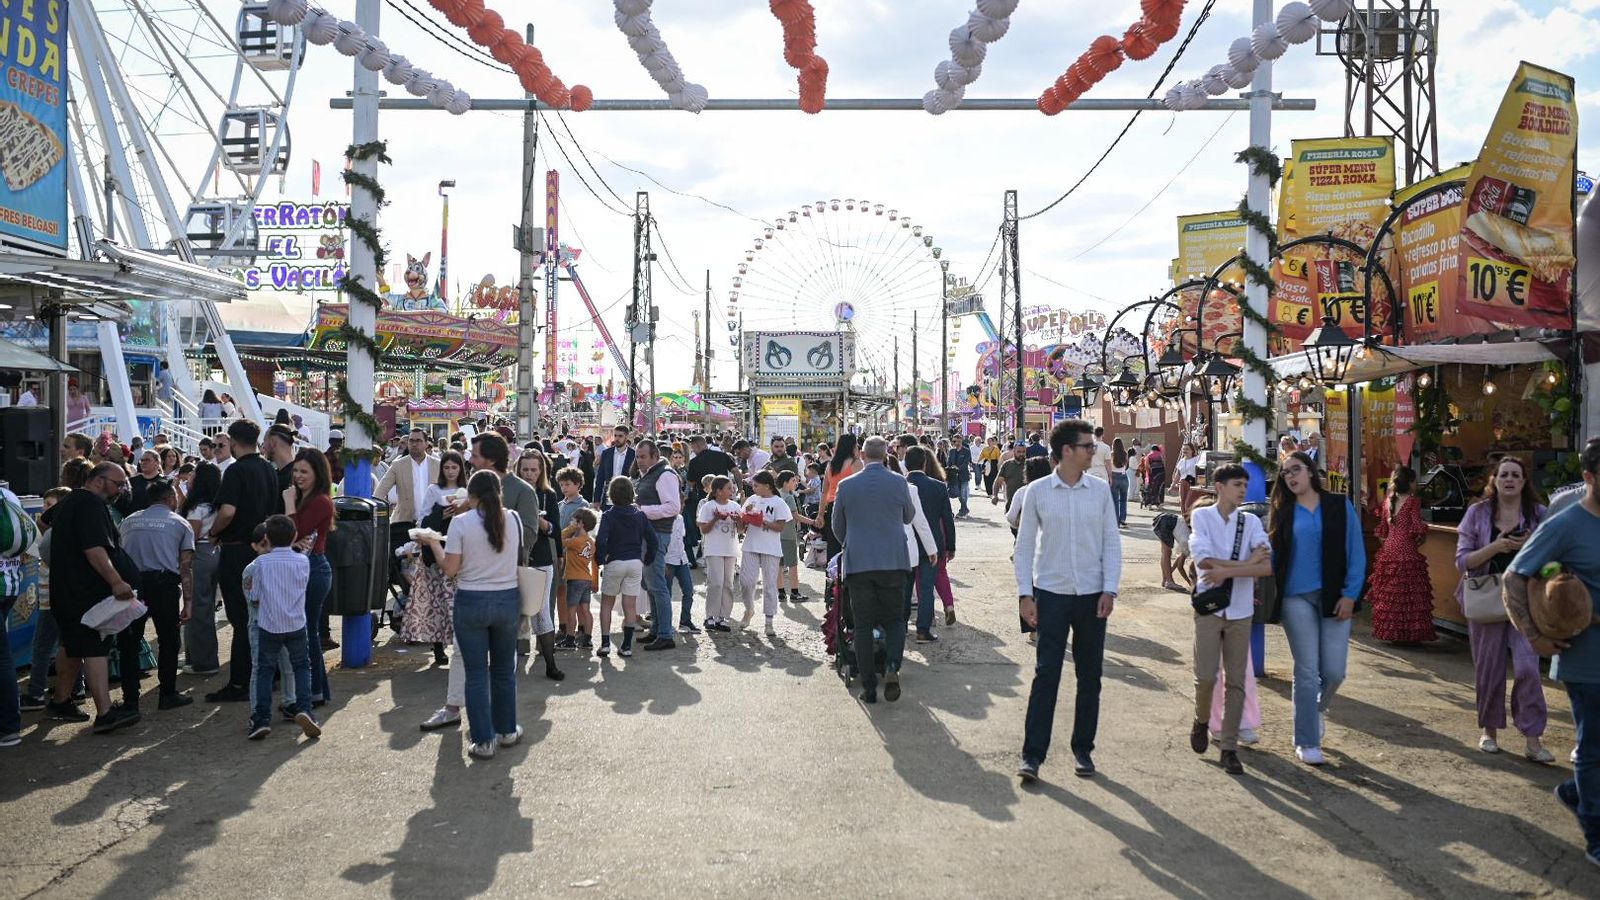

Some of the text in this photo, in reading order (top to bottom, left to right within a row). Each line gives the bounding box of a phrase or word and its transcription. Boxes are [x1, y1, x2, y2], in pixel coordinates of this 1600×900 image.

[1, 0, 59, 34] ES
[7, 67, 59, 107] CREPES
[1306, 149, 1379, 160] PIZZERÍA ROMA
[1309, 160, 1377, 175] SÚPER MENÚ
[1310, 174, 1377, 187] PIZZA ROMA
[269, 238, 298, 257] EL
[1288, 259, 1298, 272] 6
[1276, 289, 1288, 299] de
[1280, 281, 1308, 294] Vaso
[1282, 306, 1309, 325] 8 €
[766, 506, 774, 515] N
